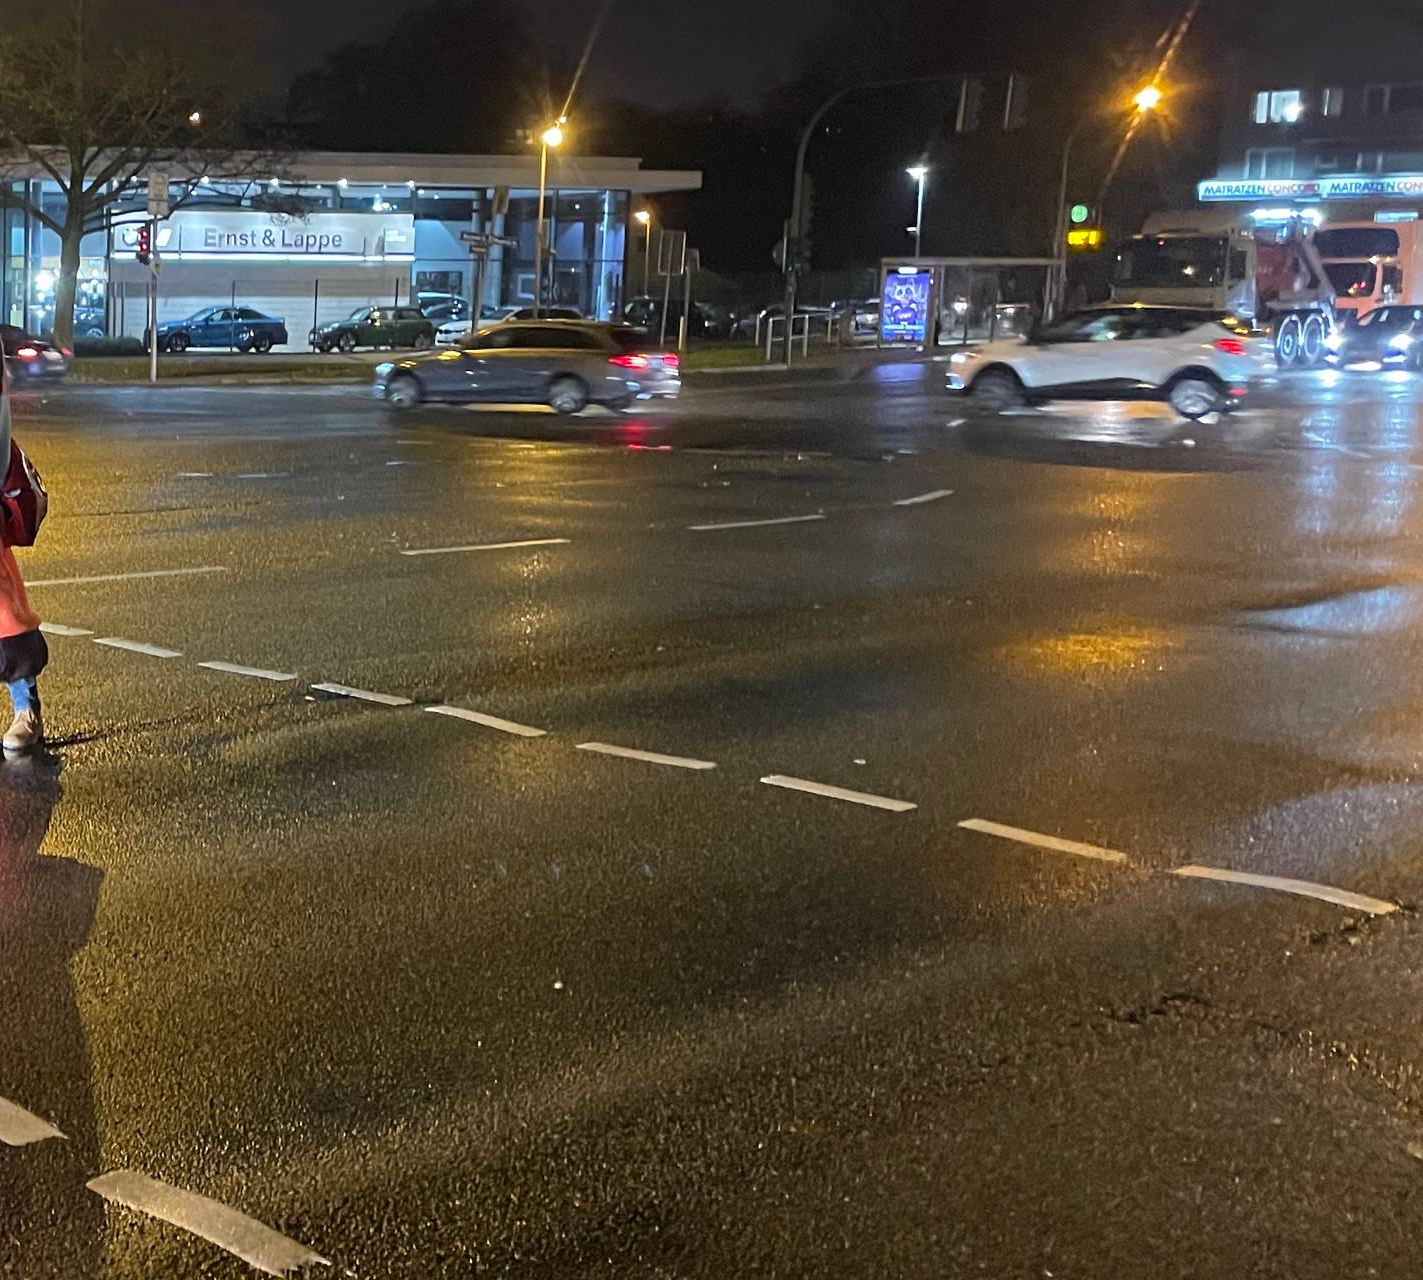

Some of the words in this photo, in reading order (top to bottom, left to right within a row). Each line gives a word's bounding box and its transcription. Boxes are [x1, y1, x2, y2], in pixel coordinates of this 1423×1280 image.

[1204, 183, 1265, 195] MATRATZEN
[1267, 183, 1320, 193] CONCOD
[1330, 181, 1395, 192] MATRAN
[204, 228, 256, 248] Ernst
[262, 229, 275, 248] &
[281, 229, 342, 253] Lappe
